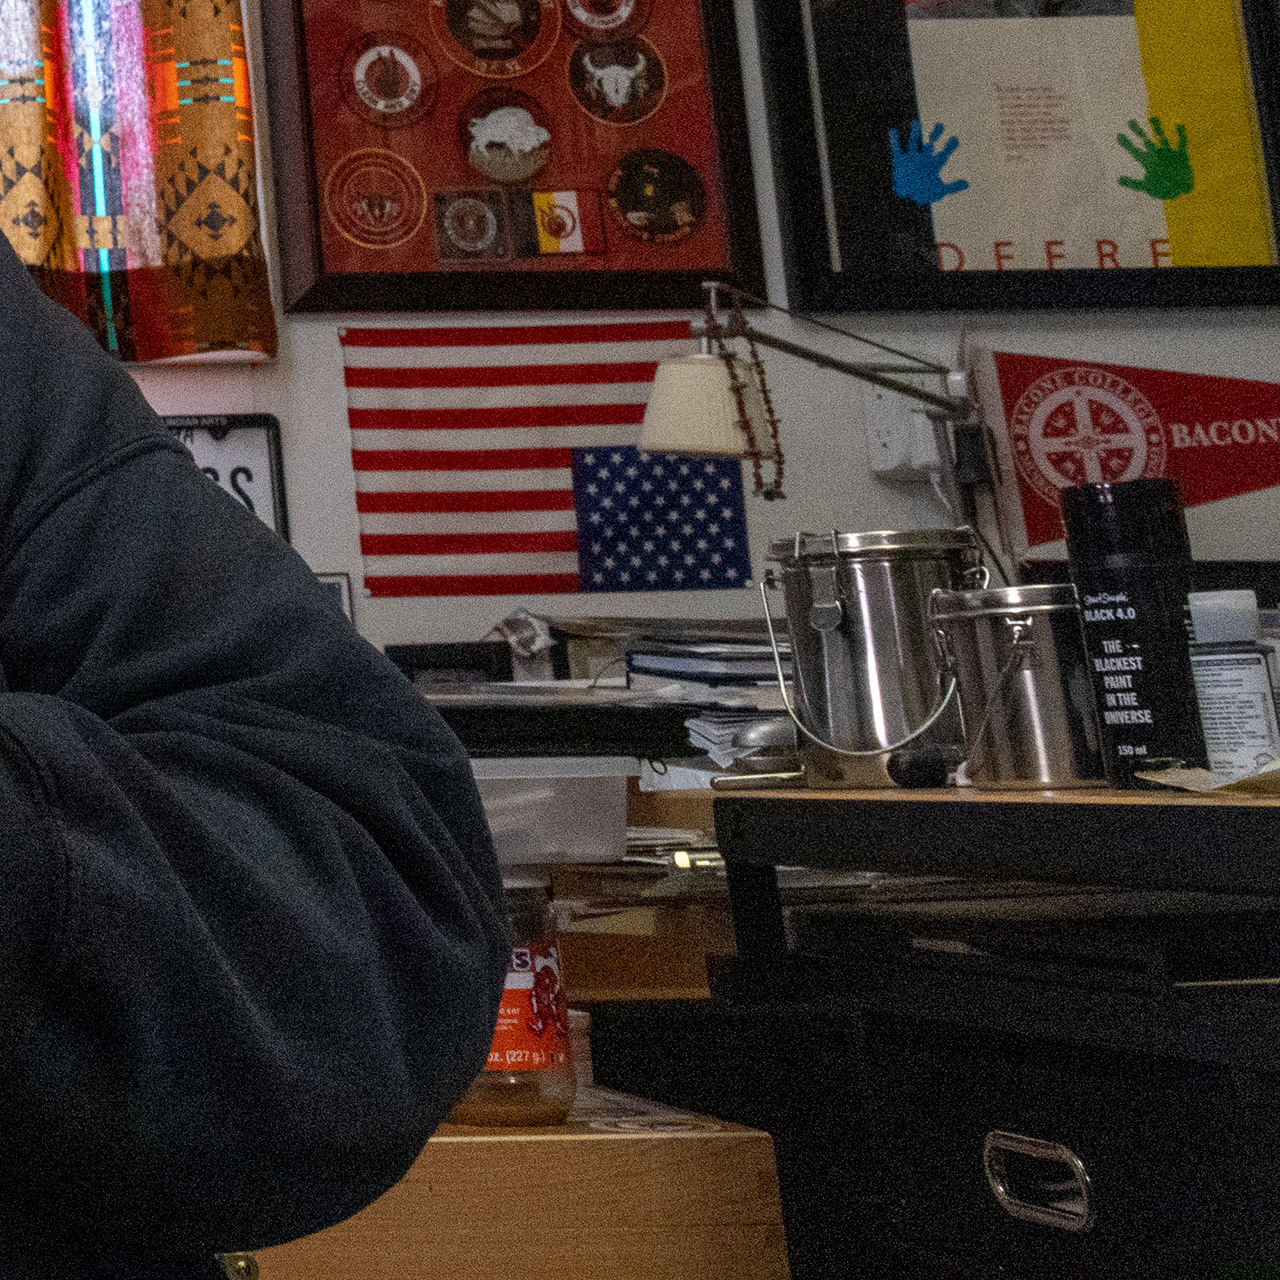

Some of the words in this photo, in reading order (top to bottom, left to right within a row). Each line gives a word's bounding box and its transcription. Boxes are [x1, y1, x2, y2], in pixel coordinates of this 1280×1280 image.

[1073, 371, 1158, 429] COLLEGE
[1169, 417, 1280, 449] BACON
[1083, 608, 1116, 622] BLACK
[1115, 606, 1137, 620] 4.0
[1101, 639, 1124, 654] THE
[1093, 655, 1144, 673] BLACKEST
[1103, 674, 1134, 690] PAINT
[1104, 692, 1118, 707] IN
[1117, 691, 1140, 707] THE
[1102, 708, 1154, 726] UNIVERSE
[1116, 744, 1134, 756] 150
